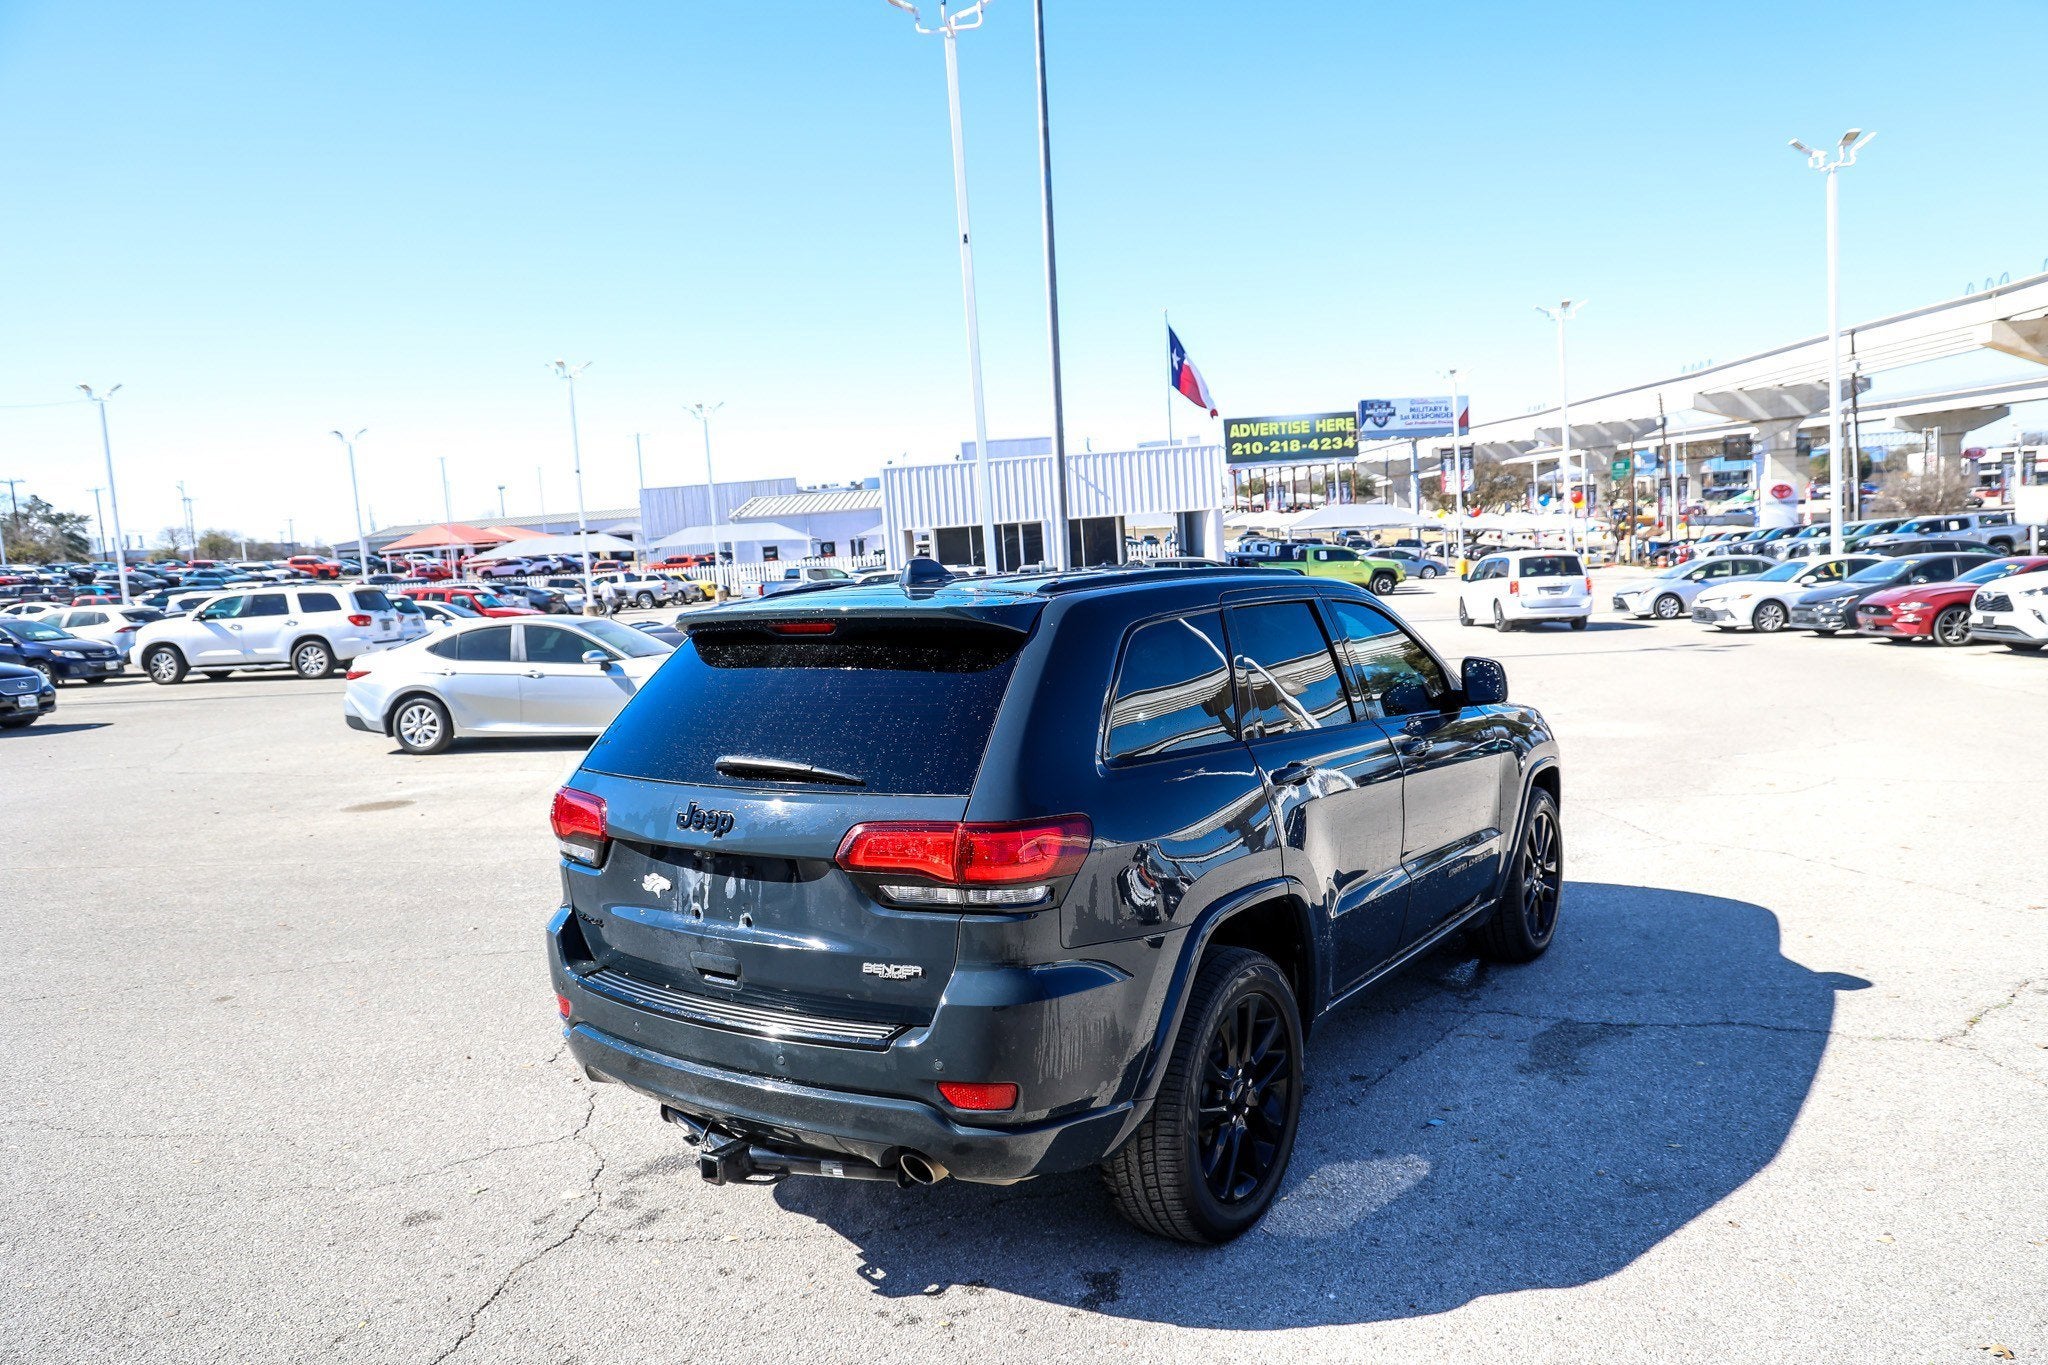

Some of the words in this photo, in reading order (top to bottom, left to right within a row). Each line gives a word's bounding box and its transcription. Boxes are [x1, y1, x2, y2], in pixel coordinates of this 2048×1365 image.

[1409, 405, 1442, 413] MILITARY
[1229, 421, 1310, 438] ADVERTISE
[1315, 417, 1355, 433] HERE
[1231, 436, 1355, 455] 210-218-4234
[676, 802, 735, 838] Jeep
[862, 962, 922, 976] BENDER
